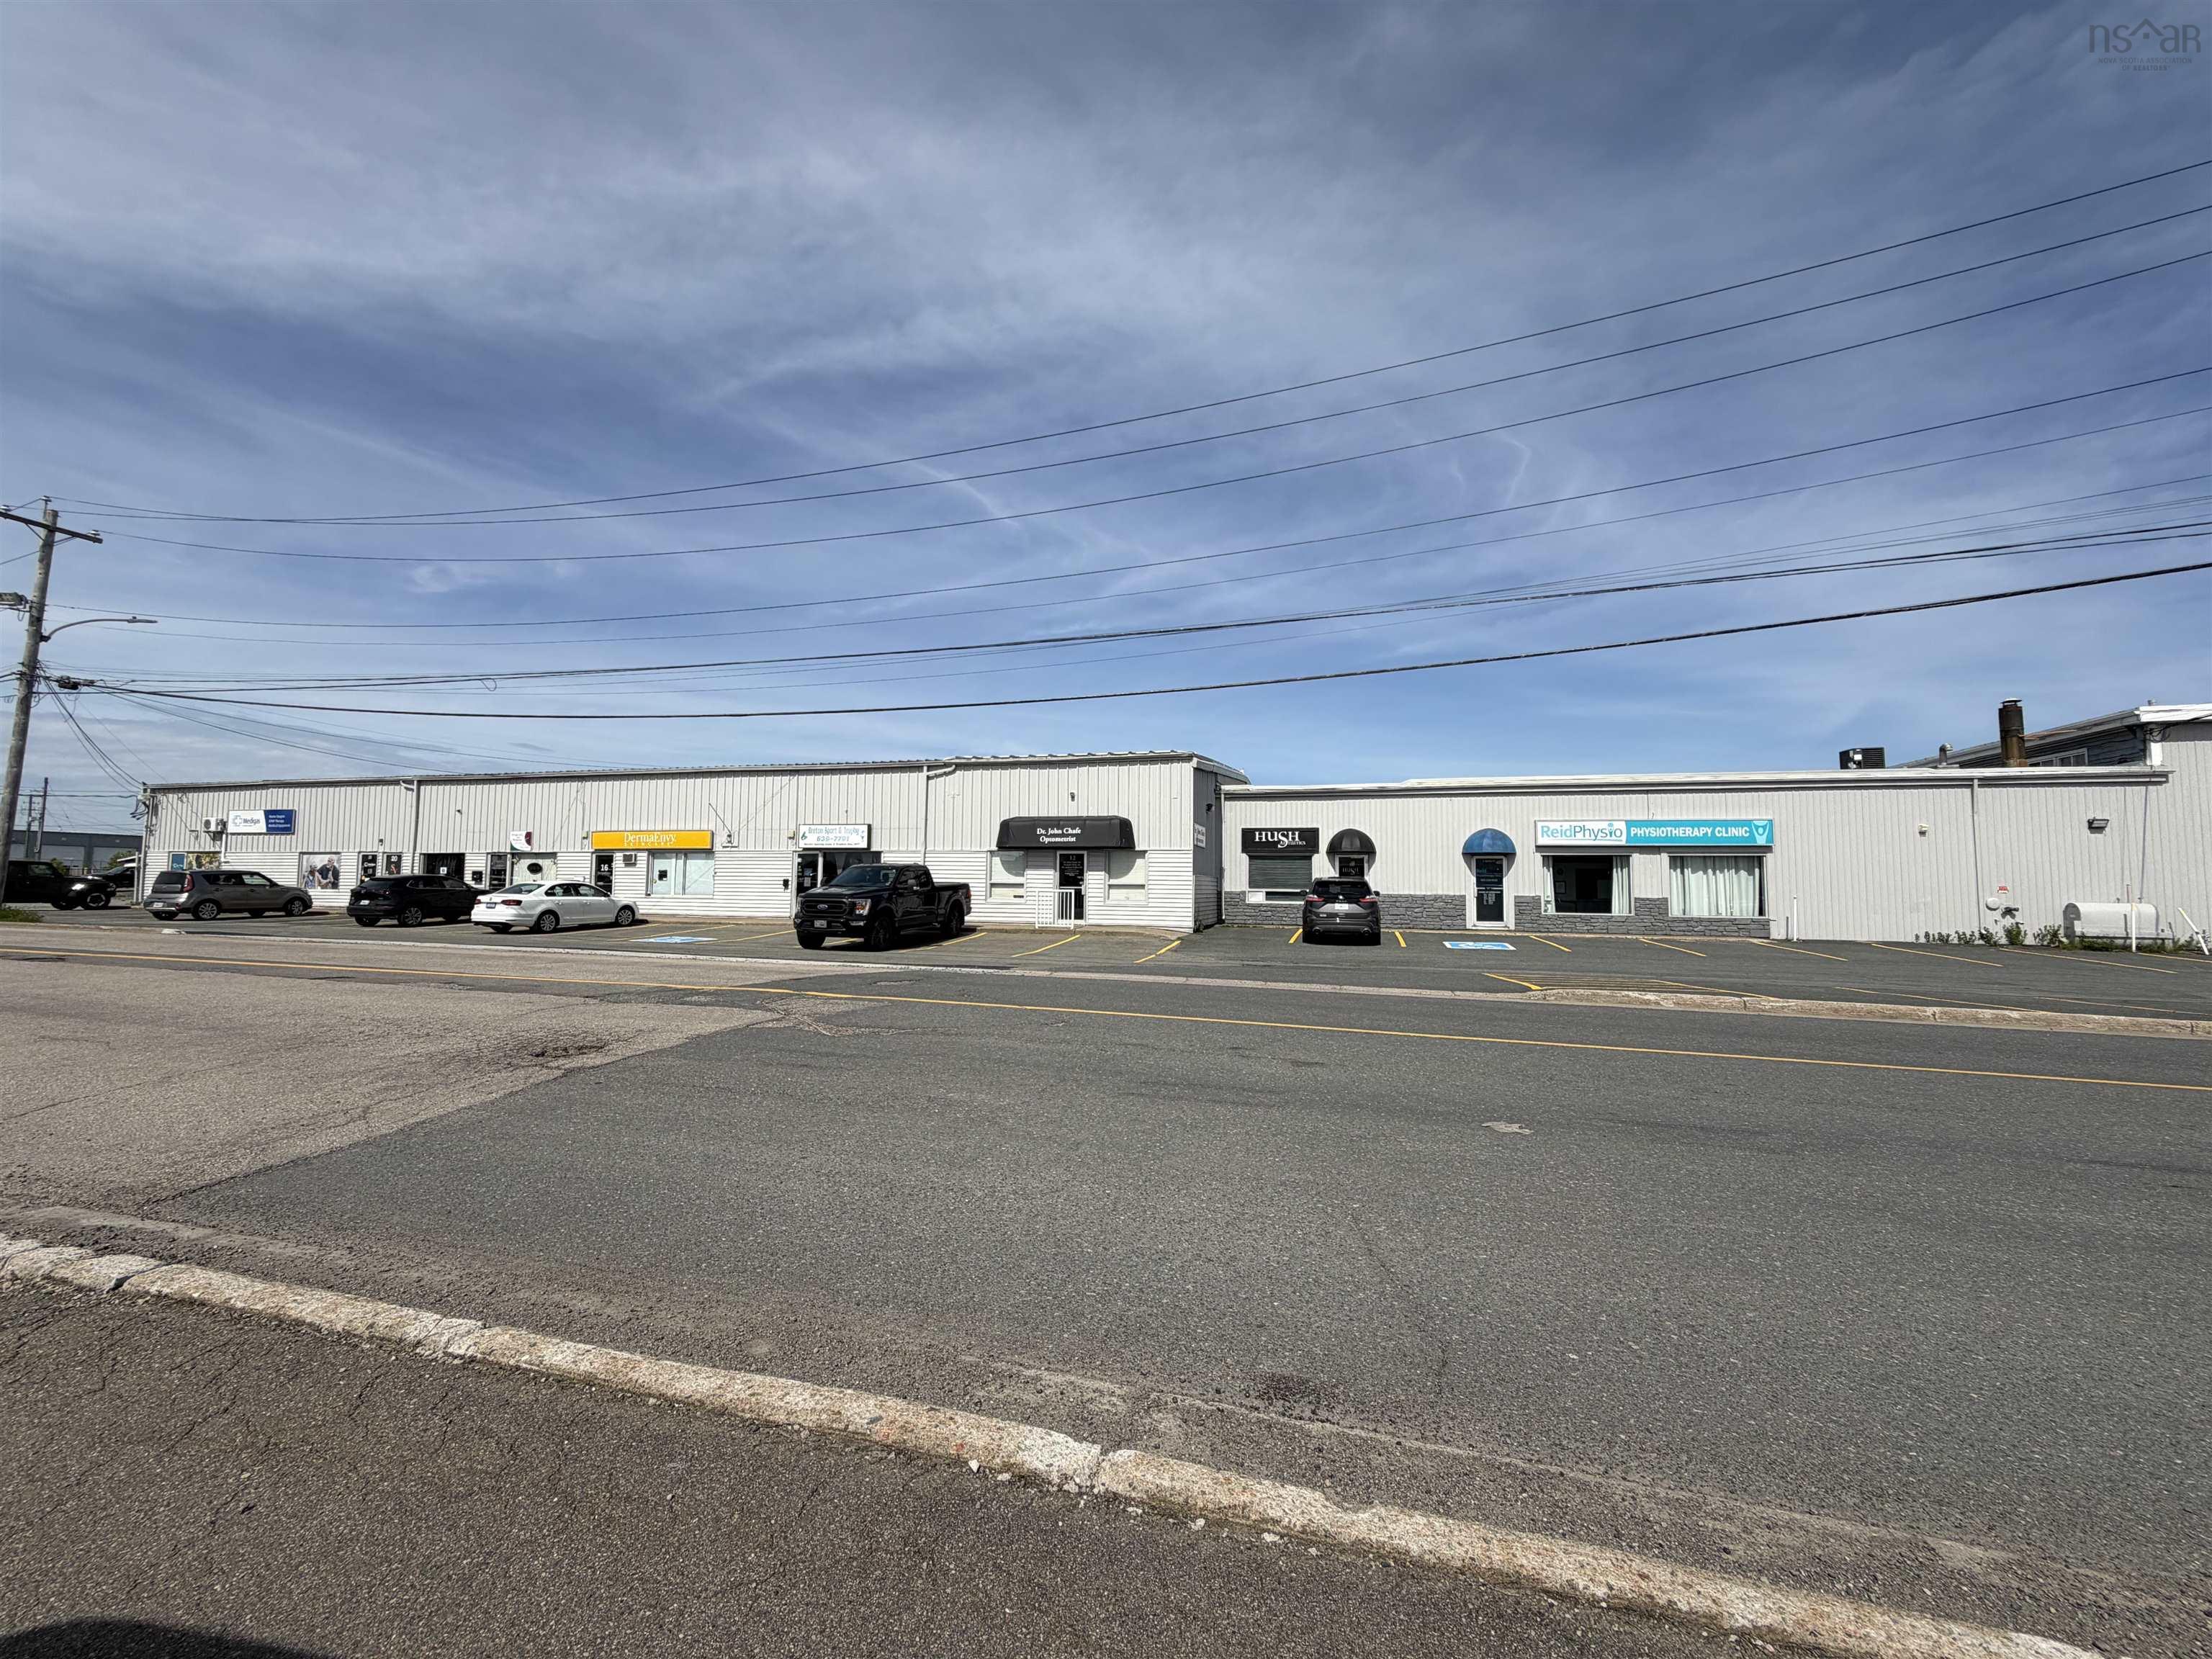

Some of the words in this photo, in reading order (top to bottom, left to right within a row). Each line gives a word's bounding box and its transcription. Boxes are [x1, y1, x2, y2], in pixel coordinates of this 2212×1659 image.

[624, 832, 675, 843] DermaEnvy
[1630, 827, 1712, 837] PHYSIOTHERAPY
[1714, 827, 1750, 837] CLINIC
[1254, 831, 1300, 848] HUSH
